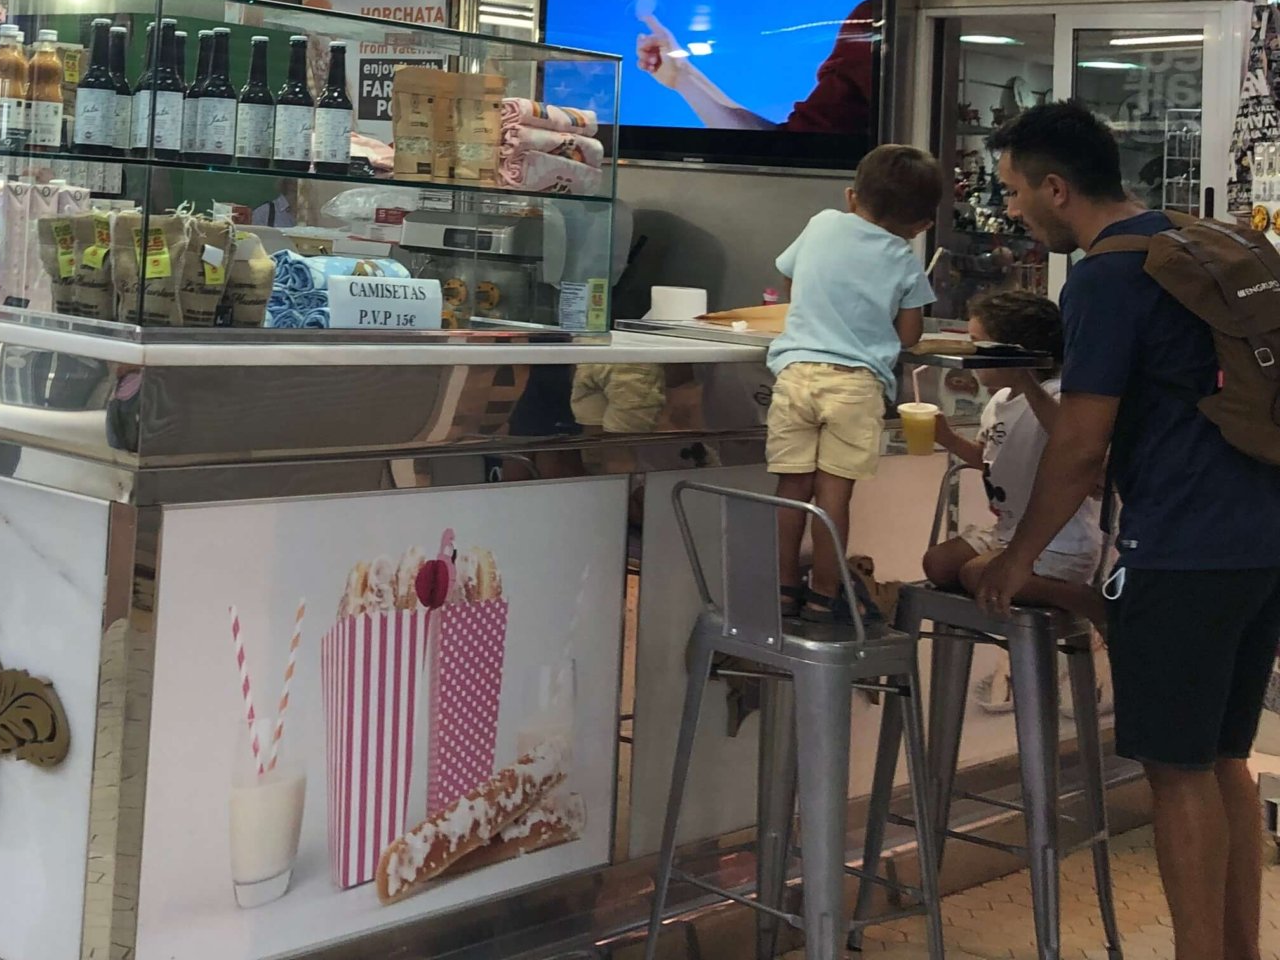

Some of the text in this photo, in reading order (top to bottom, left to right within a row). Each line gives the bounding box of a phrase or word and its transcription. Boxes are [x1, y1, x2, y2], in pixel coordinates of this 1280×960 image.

[360, 6, 445, 24] HORCHATA
[363, 60, 395, 78] enjoy
[348, 280, 427, 301] CAMISETAS
[358, 309, 417, 328] P.V.P 15€
